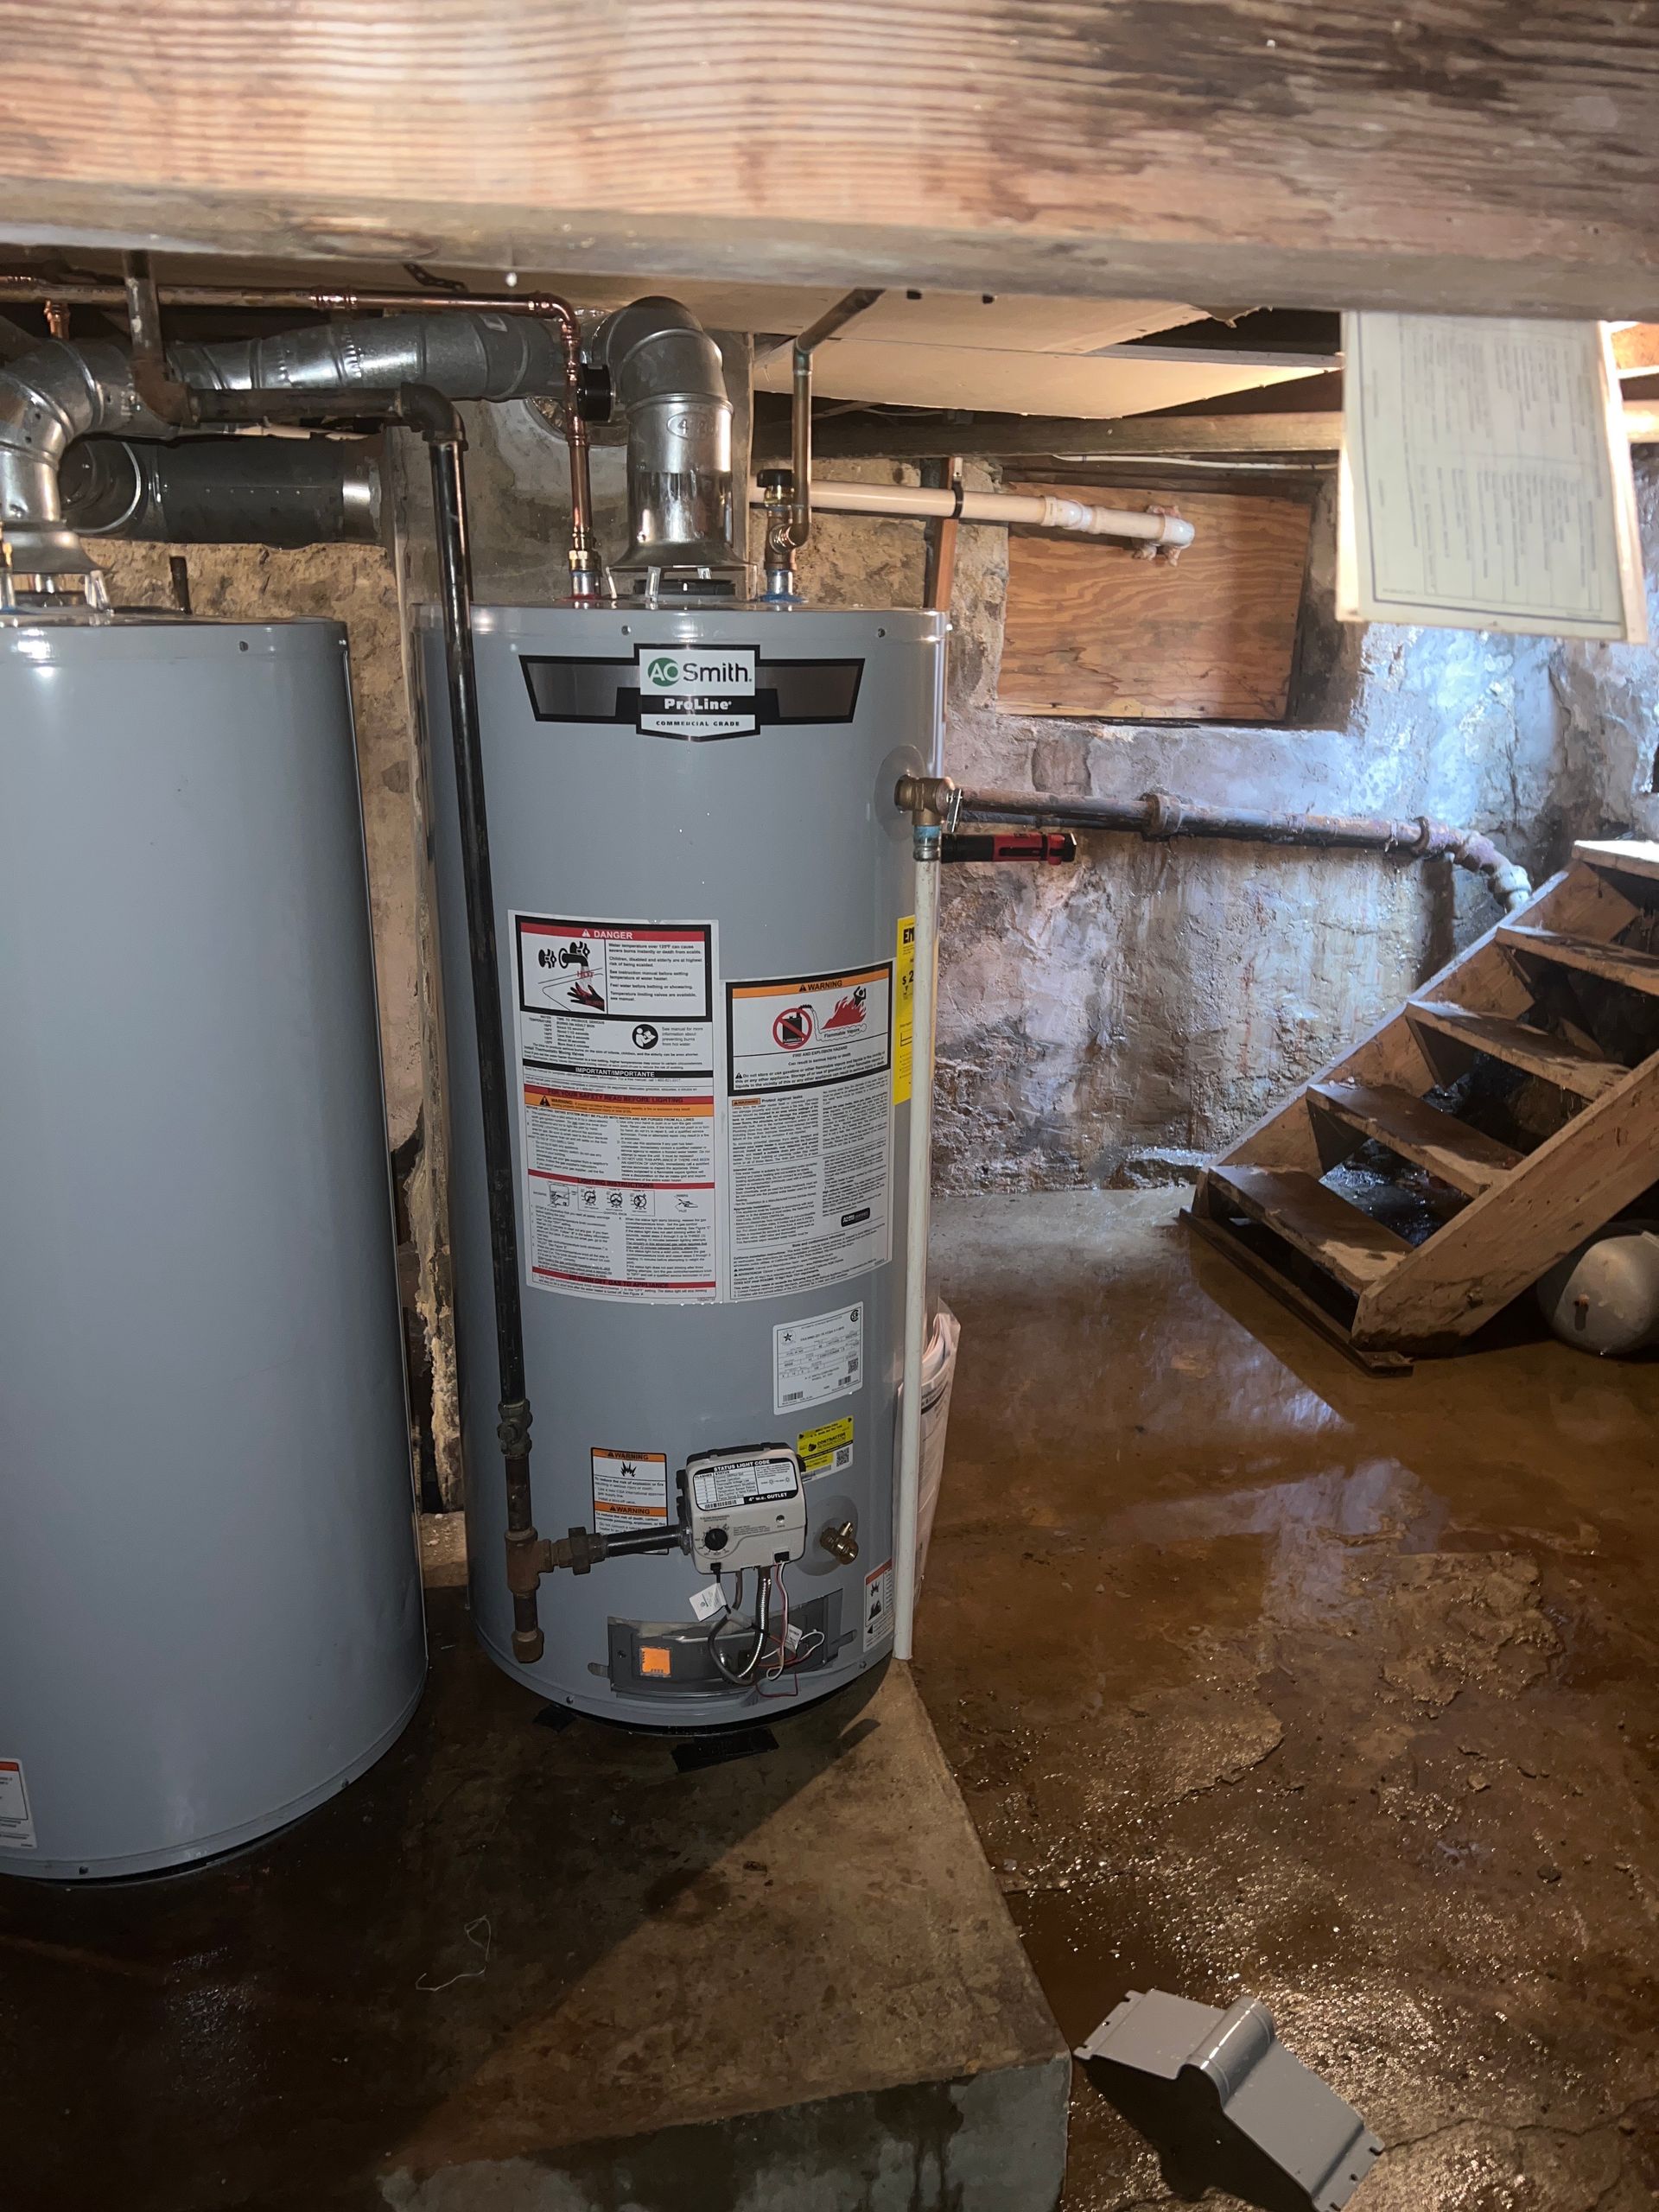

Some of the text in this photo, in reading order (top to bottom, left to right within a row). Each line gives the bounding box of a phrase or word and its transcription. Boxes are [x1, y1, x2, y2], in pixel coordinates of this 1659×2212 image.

[664, 698, 728, 710] ProLine
[594, 930, 633, 940] DANGER
[808, 980, 842, 991] WARNING
[575, 1067, 655, 1077] IMPORTANT/IMPORTANTE
